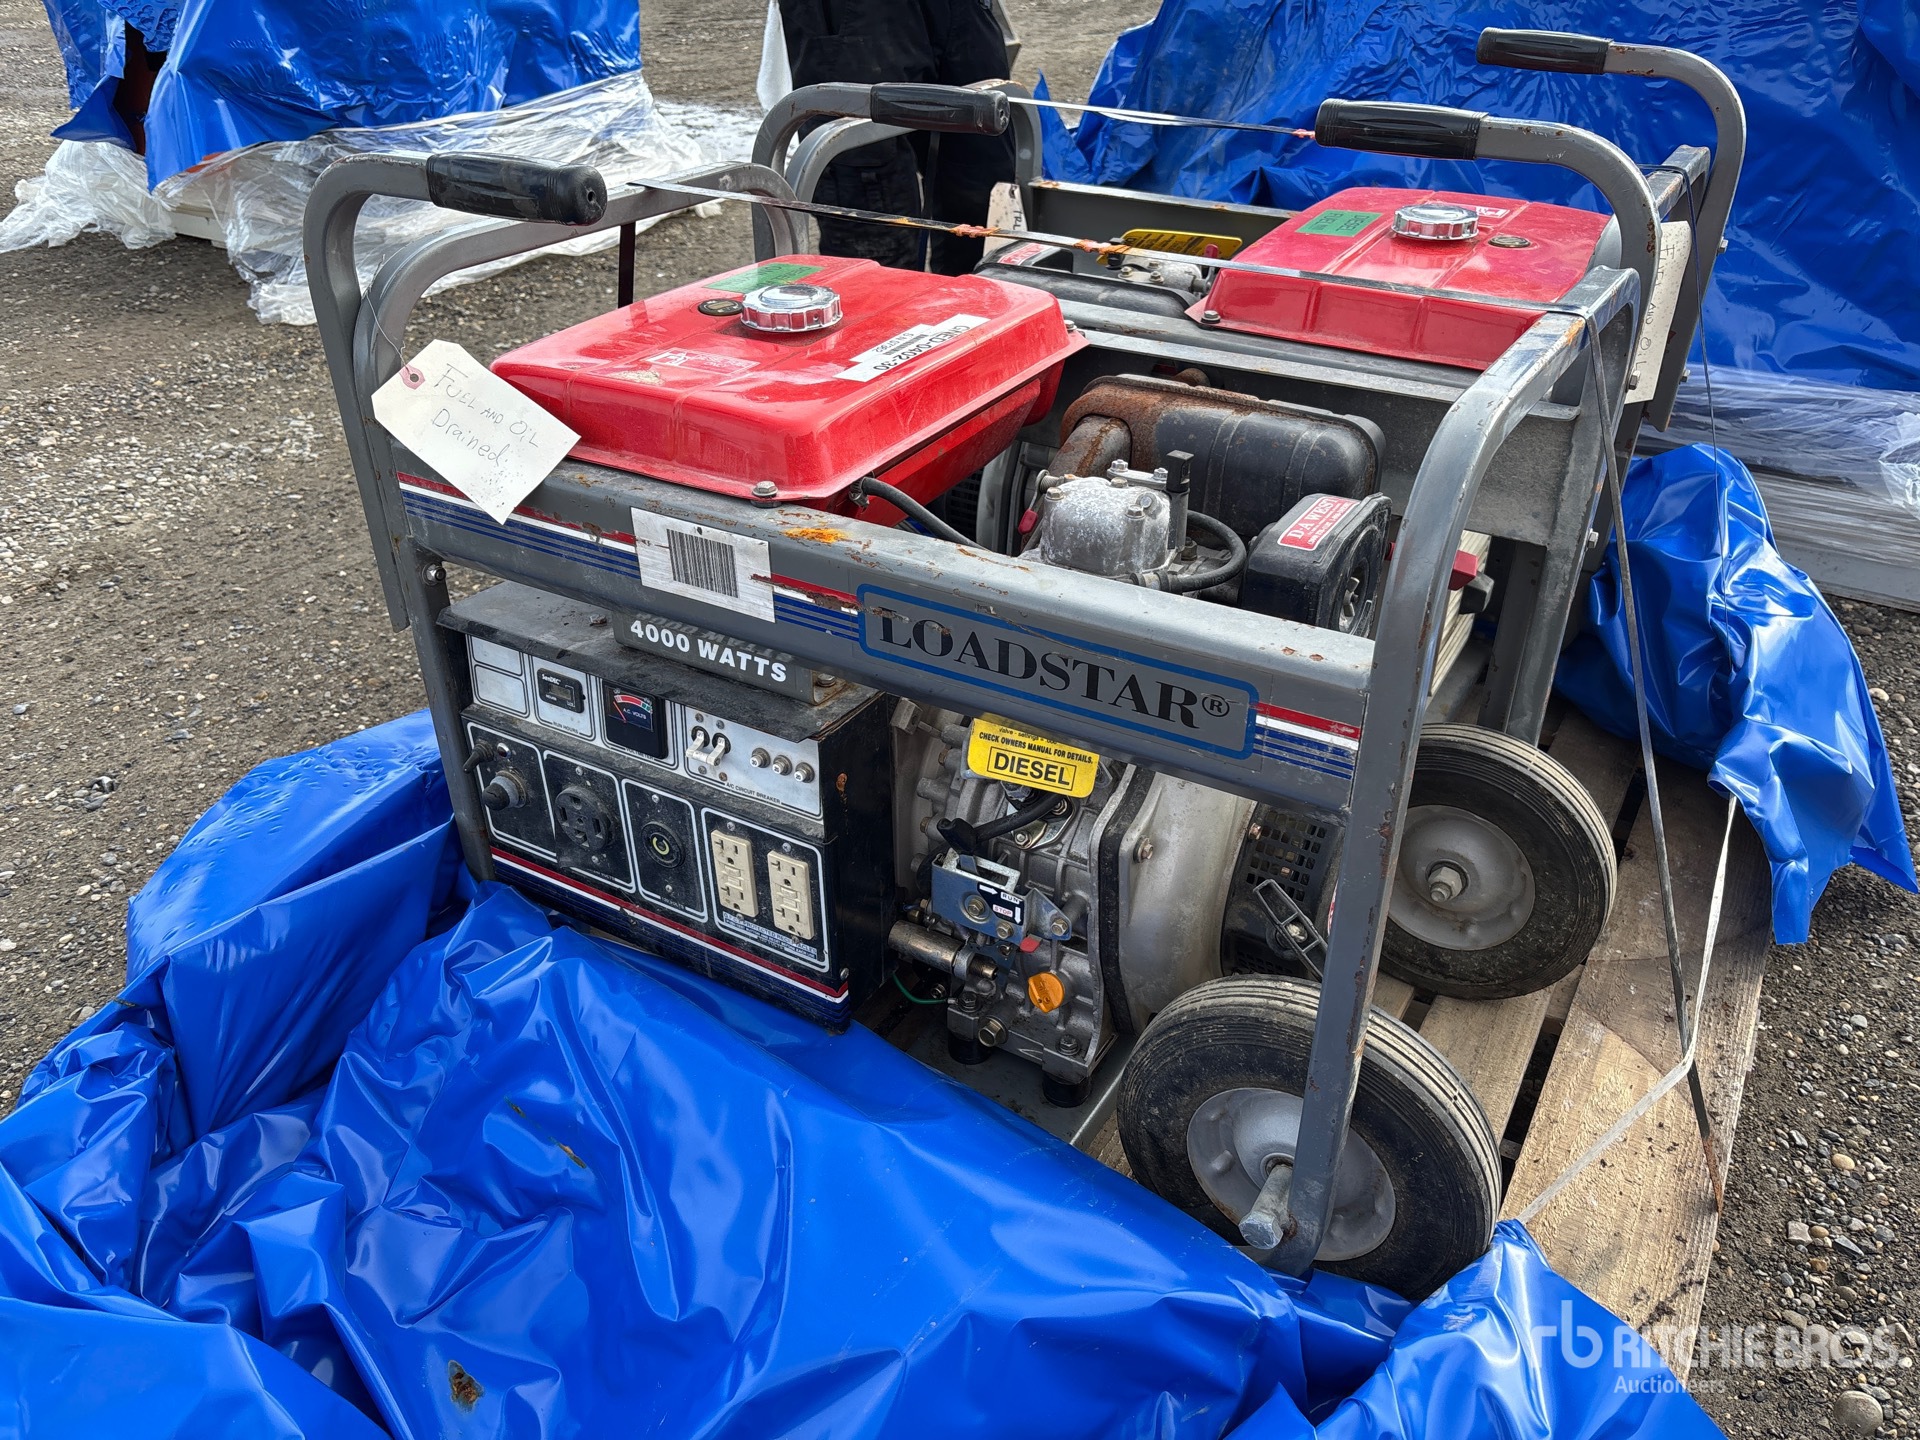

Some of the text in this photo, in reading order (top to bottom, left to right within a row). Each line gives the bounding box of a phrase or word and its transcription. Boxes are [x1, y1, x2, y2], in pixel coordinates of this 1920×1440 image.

[480, 408, 504, 425] AND
[630, 619, 787, 682] 4000 WATTS
[979, 731, 1094, 764] CHECK OWNERS MANUAL FOR DETAILS.
[994, 752, 1070, 786] DIESEL
[735, 785, 755, 796] CIRCUIT
[756, 791, 781, 804] BREAKER
[1002, 893, 1019, 903] RUN
[994, 906, 1012, 916] STOP
